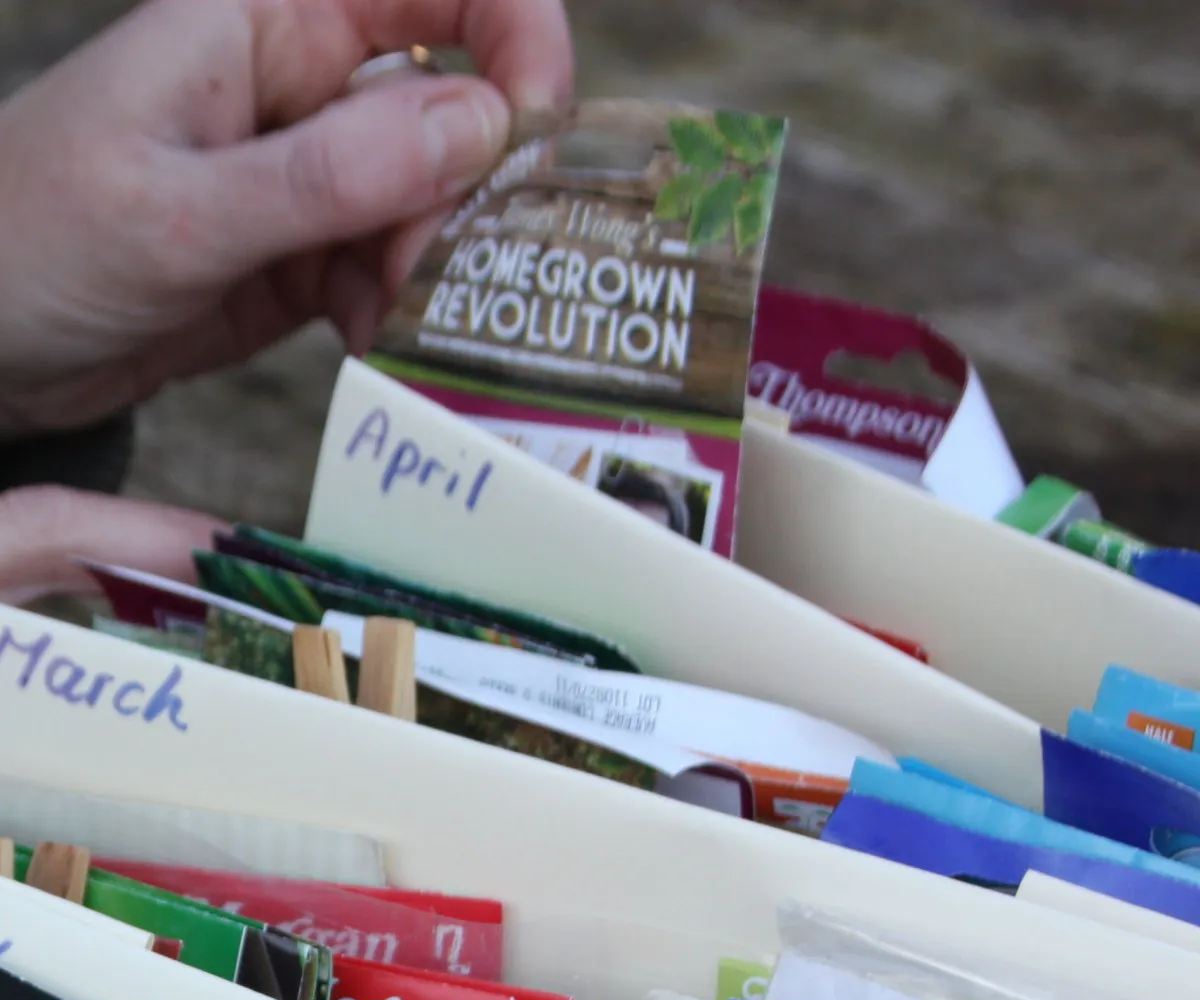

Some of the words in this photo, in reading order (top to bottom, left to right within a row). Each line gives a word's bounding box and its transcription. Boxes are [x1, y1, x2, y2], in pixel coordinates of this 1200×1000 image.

[443, 237, 695, 318] HOMEGROWN
[422, 280, 691, 370] REVOLUTION
[345, 405, 493, 514] April
